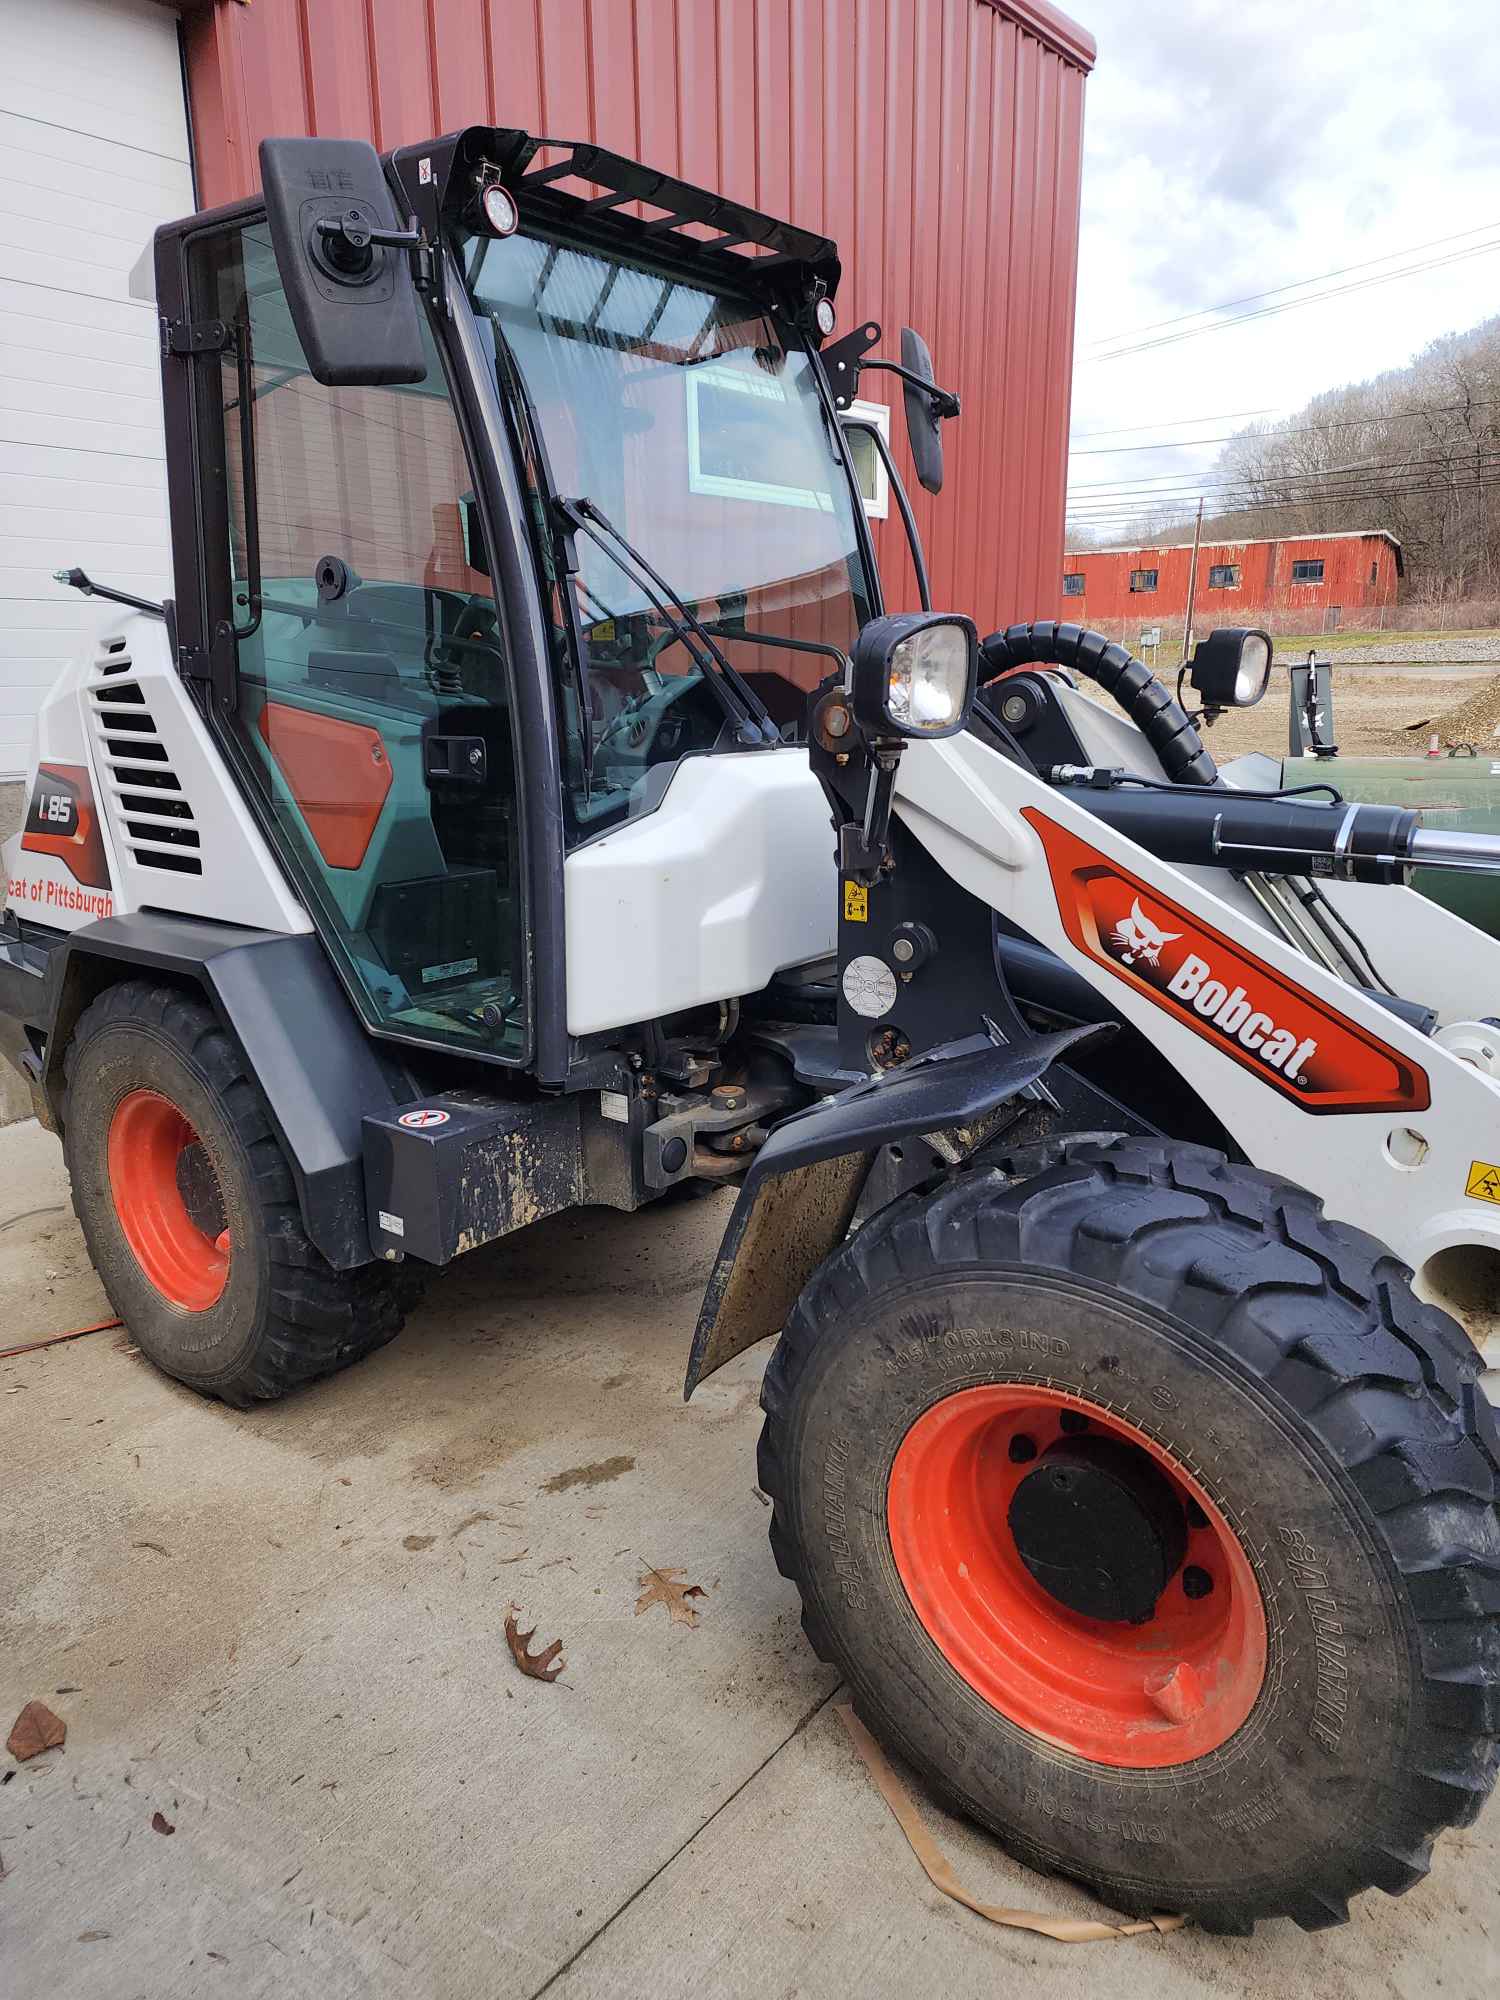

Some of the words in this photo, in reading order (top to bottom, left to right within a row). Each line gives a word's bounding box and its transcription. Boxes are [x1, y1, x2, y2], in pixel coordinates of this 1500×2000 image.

[39, 794, 73, 823] L85
[31, 879, 43, 902] of
[46, 880, 113, 921] Pittsburgh
[1166, 953, 1318, 1079] Bobcat
[823, 1430, 864, 1586] ALLIANCE
[1286, 1557, 1349, 1752] ALLIANCE
